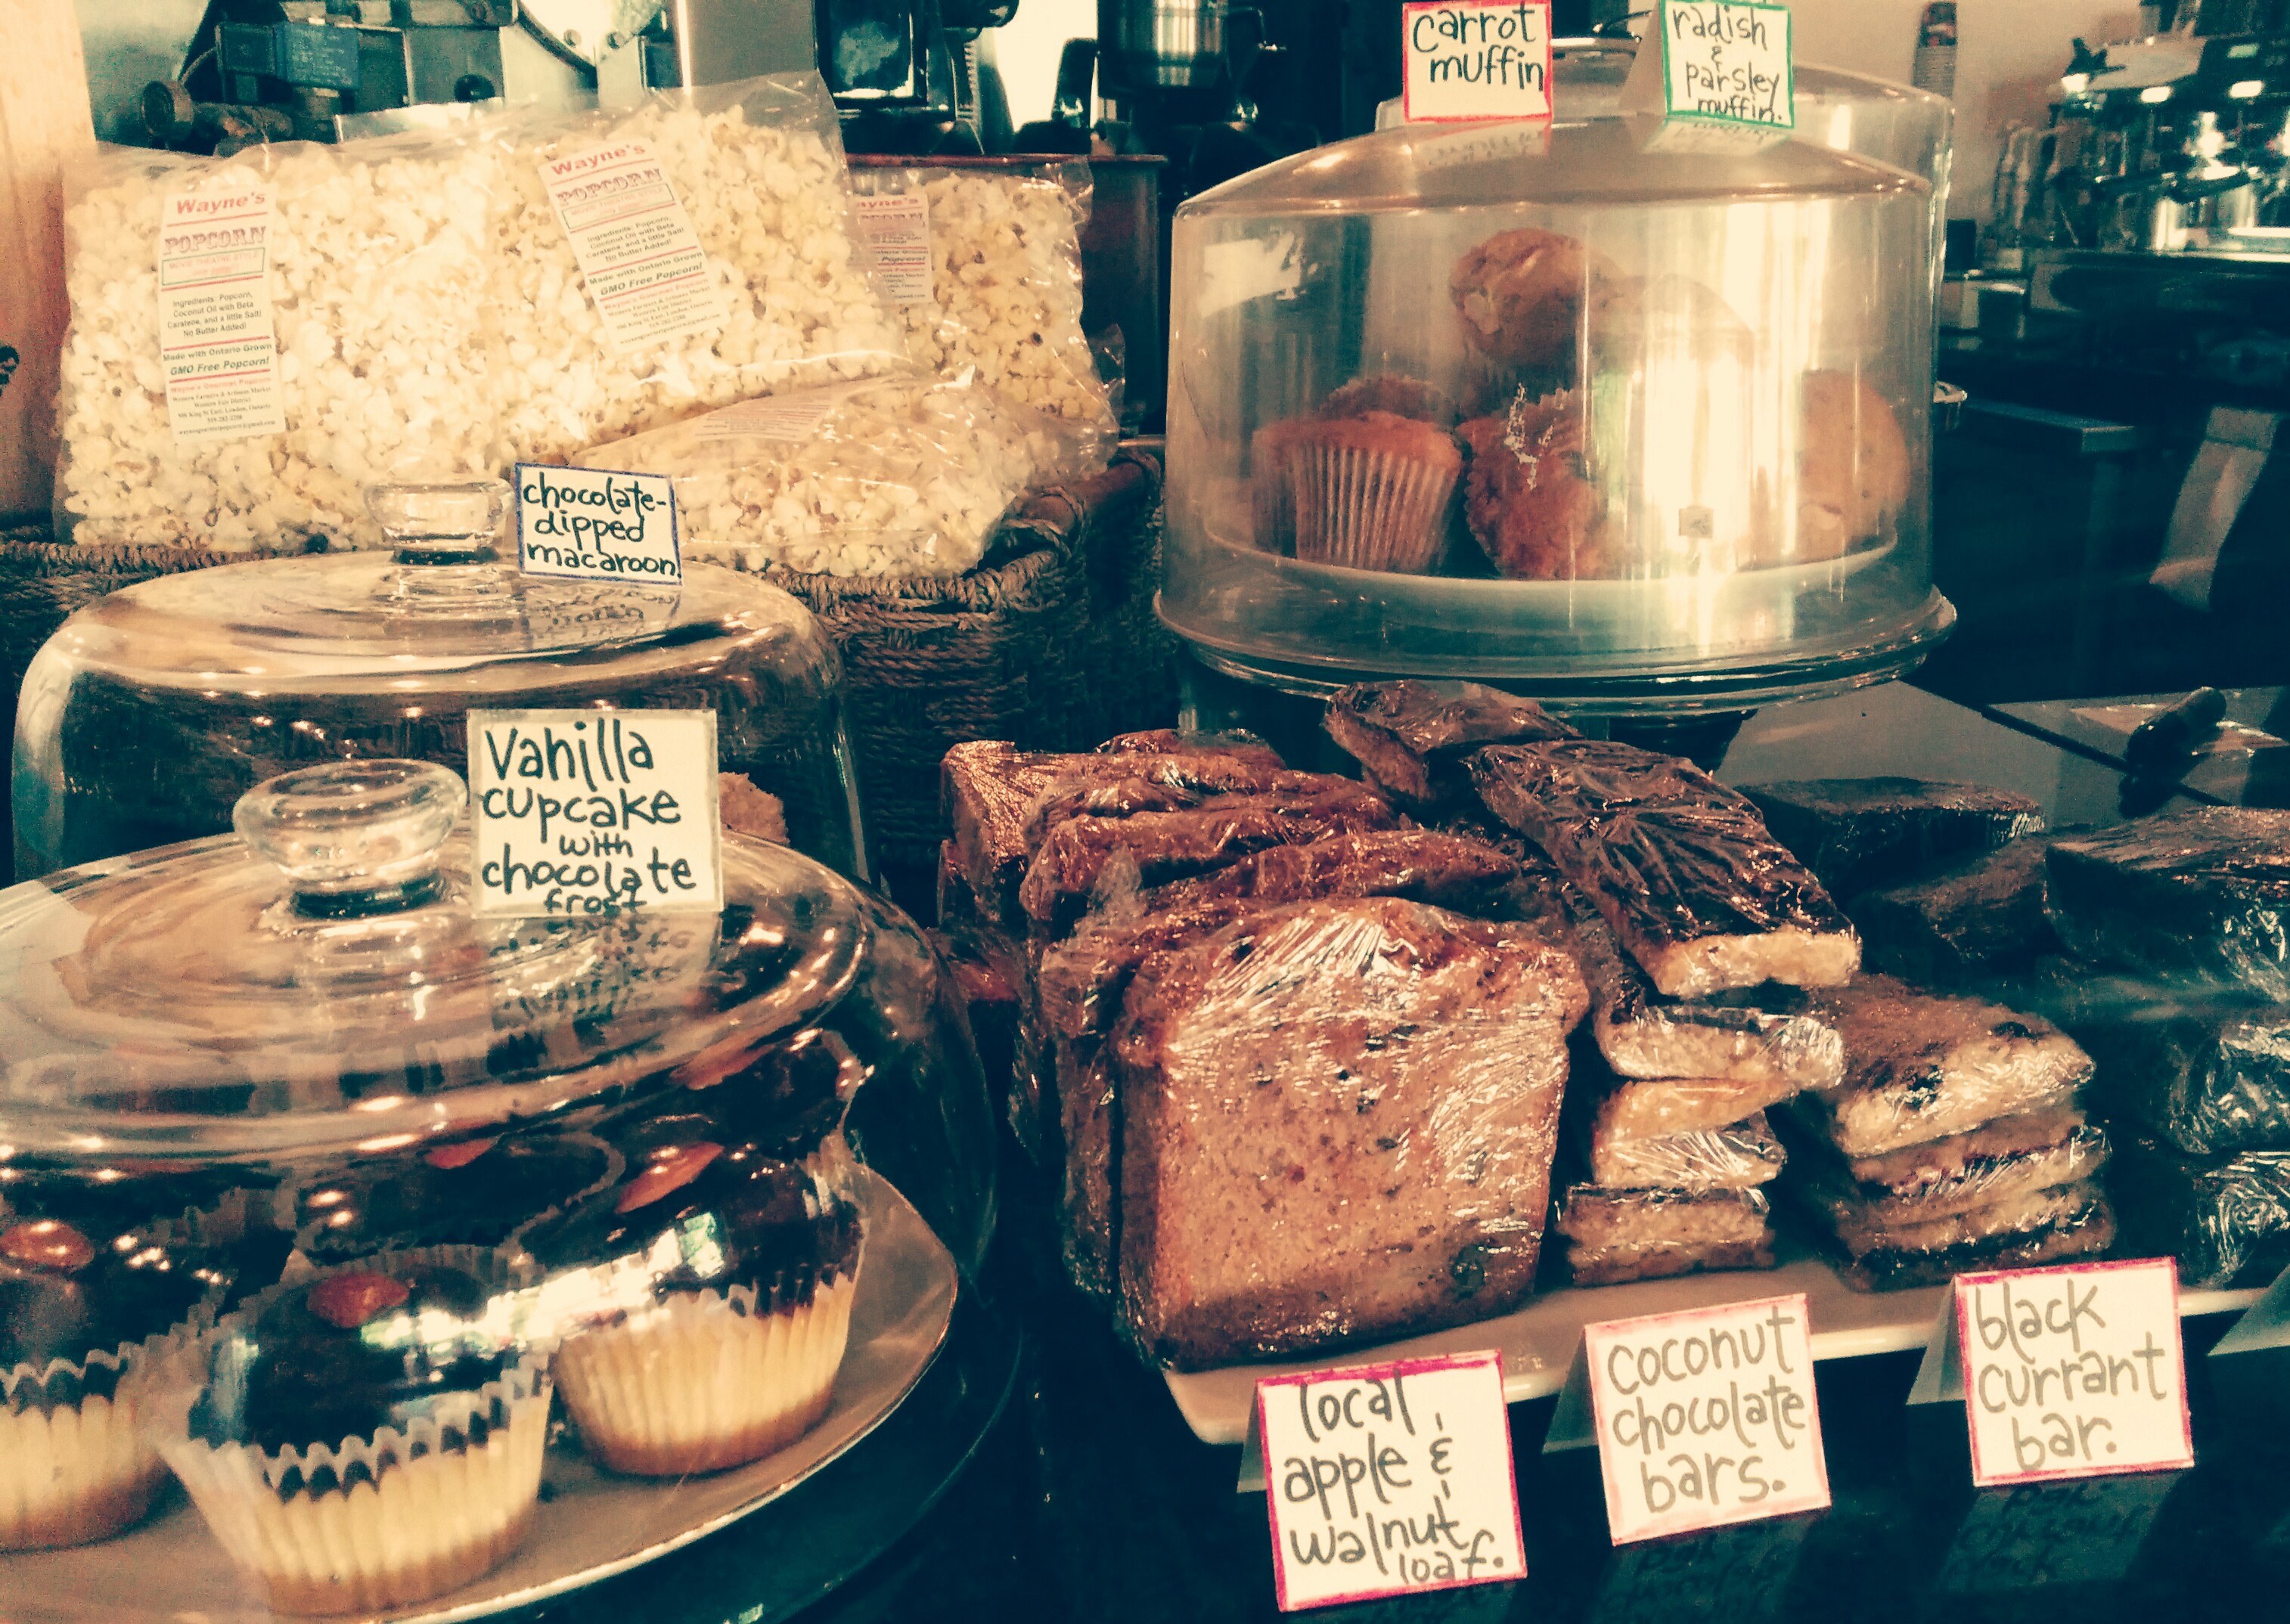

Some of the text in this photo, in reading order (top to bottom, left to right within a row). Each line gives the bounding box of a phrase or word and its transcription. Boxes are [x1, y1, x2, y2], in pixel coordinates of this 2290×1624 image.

[1672, 2, 1768, 50] radish
[1431, 45, 1544, 91] muffin
[1685, 62, 1780, 99] parsley
[551, 144, 645, 175] Wayne's
[177, 192, 265, 214] Wayne's
[556, 168, 662, 206] POPCORN
[163, 226, 266, 255] POPCORN
[619, 248, 642, 257] Butter
[589, 274, 613, 284] Made
[616, 269, 636, 277] with
[674, 252, 702, 262] Grown
[600, 262, 702, 296] GMO Free Popcorn!
[174, 307, 204, 318] Coconut
[206, 305, 216, 313] Oil
[219, 303, 234, 311] with
[204, 315, 218, 324] and
[196, 327, 218, 335] Butter
[163, 343, 272, 361] Made with Ontario Grown
[170, 356, 269, 376] GMO Free Popcorn!
[523, 471, 666, 519] chocolate-
[535, 510, 644, 551] dipped
[483, 787, 681, 843] cupcake
[560, 830, 634, 857] with
[482, 842, 697, 895] chocolate
[544, 888, 647, 916] frost
[1975, 1278, 2105, 1365] black
[1608, 1306, 1795, 1395] coconut
[1978, 1331, 2167, 1413] currant
[1612, 1375, 1805, 1455] chocolate
[2012, 1413, 2117, 1471] bar.
[1284, 1432, 1412, 1520] apple
[1640, 1453, 1786, 1513] bars.
[1289, 1495, 1469, 1576] walnut
[1399, 1529, 1503, 1585] loaf.
